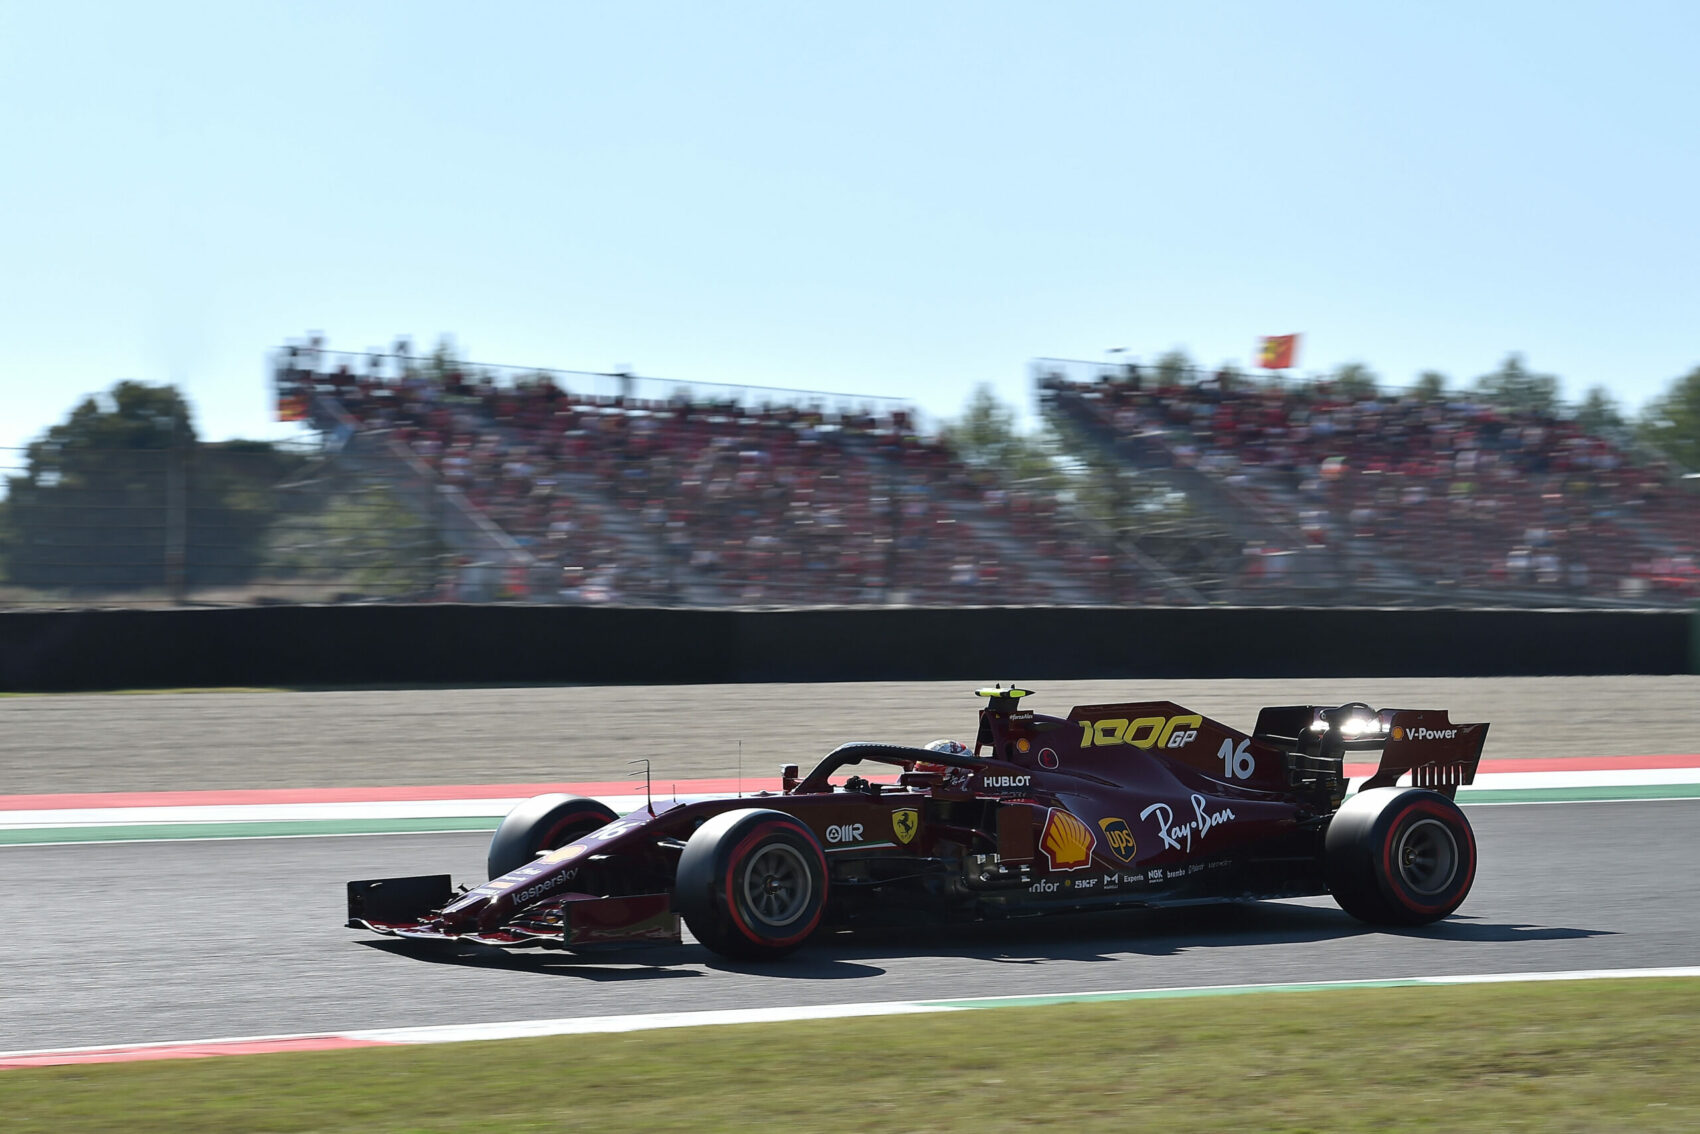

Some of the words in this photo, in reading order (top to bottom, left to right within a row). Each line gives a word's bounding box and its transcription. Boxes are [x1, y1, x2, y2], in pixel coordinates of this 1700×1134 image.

[1167, 730, 1198, 748] GP
[1406, 727, 1457, 740] V-Power
[1217, 738, 1255, 779] 16
[984, 775, 1031, 788] HUBLOT
[590, 820, 641, 841] 16
[1148, 868, 1164, 880] NGK
[1166, 868, 1186, 879] brembo
[511, 867, 579, 906] kaspersky
[1075, 878, 1098, 889] SKF
